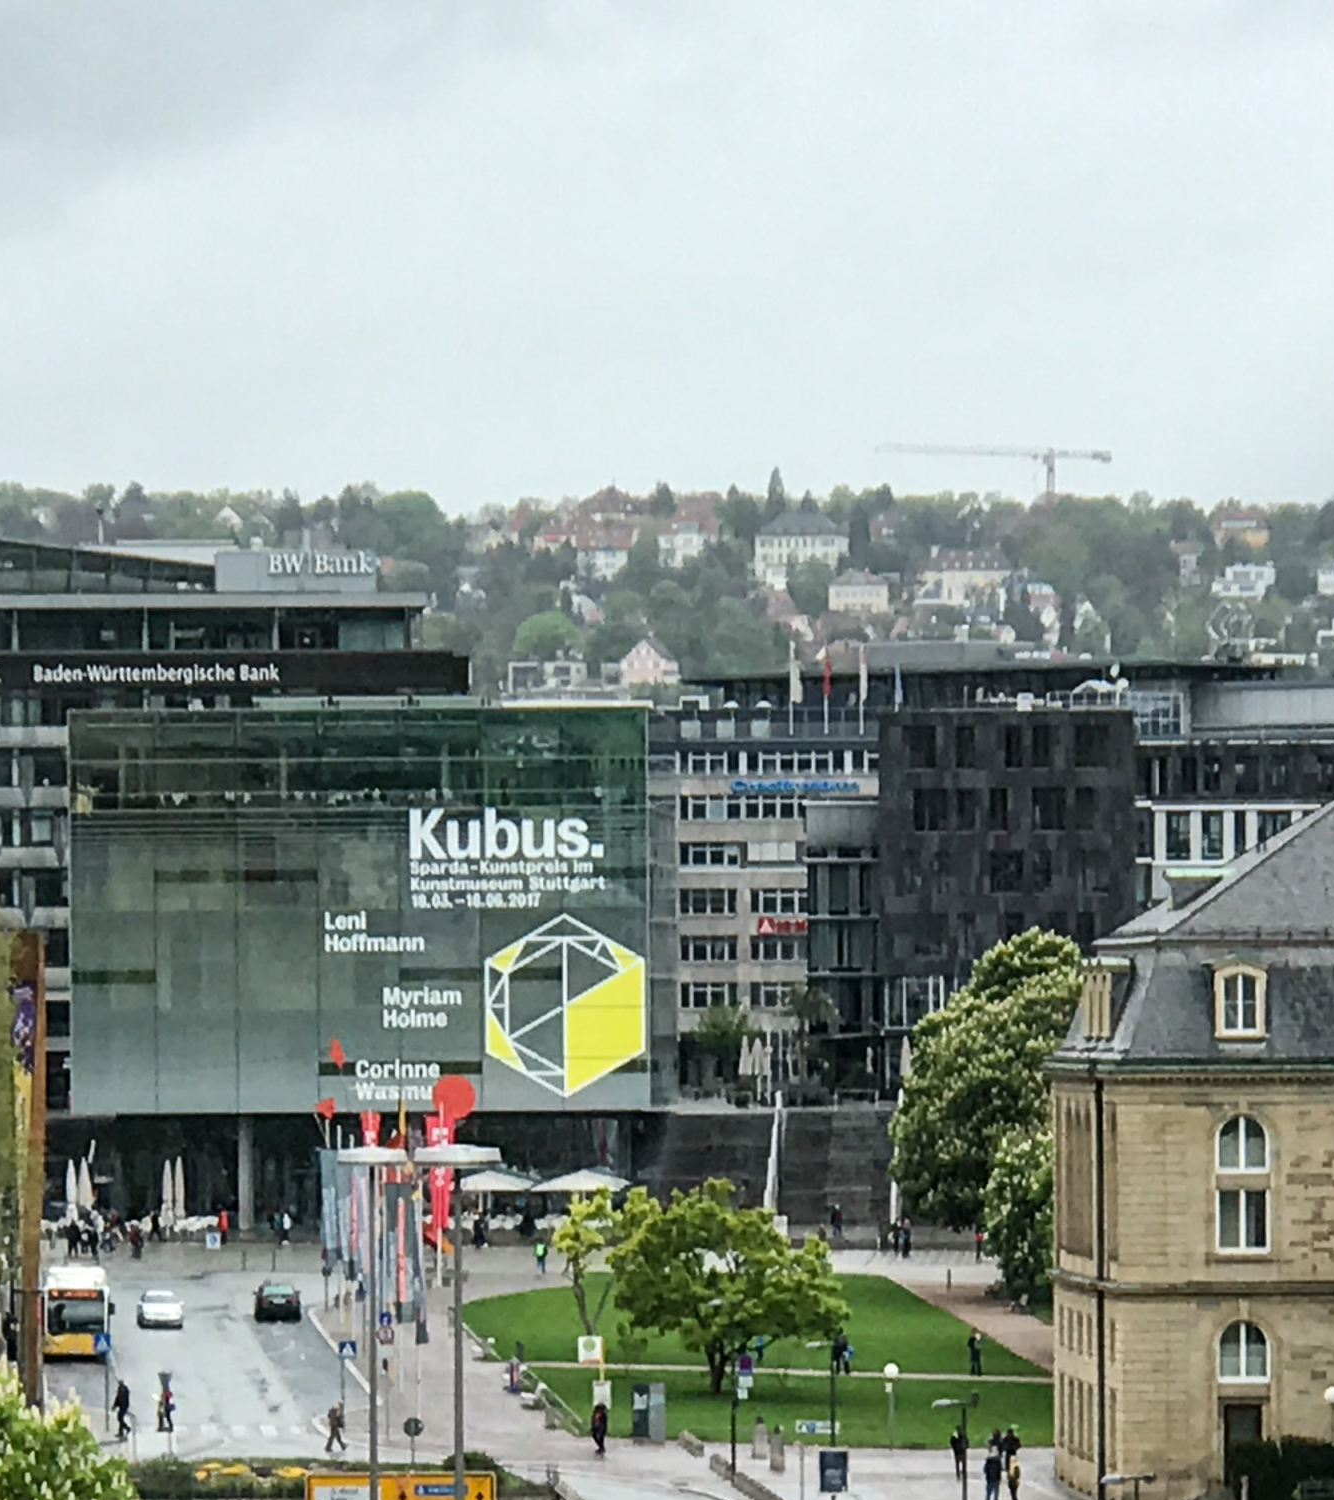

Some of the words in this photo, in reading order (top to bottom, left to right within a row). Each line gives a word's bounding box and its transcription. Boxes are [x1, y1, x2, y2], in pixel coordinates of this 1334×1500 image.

[268, 552, 303, 575] BW
[315, 551, 373, 575] Bank
[33, 663, 235, 685] Baden-Württembergische
[239, 664, 280, 682] Bank
[409, 808, 604, 858] Kubus.
[410, 860, 569, 876] Sparda-Kunstpreis
[573, 859, 593, 874] im
[410, 876, 523, 892] Kunstmuseum
[529, 875, 605, 893] Stuttgart
[324, 911, 367, 930] Leni
[324, 933, 425, 952] Hoffmann
[382, 987, 462, 1007] Myriam
[382, 1009, 448, 1028] Holme
[355, 1059, 441, 1078] Corinne
